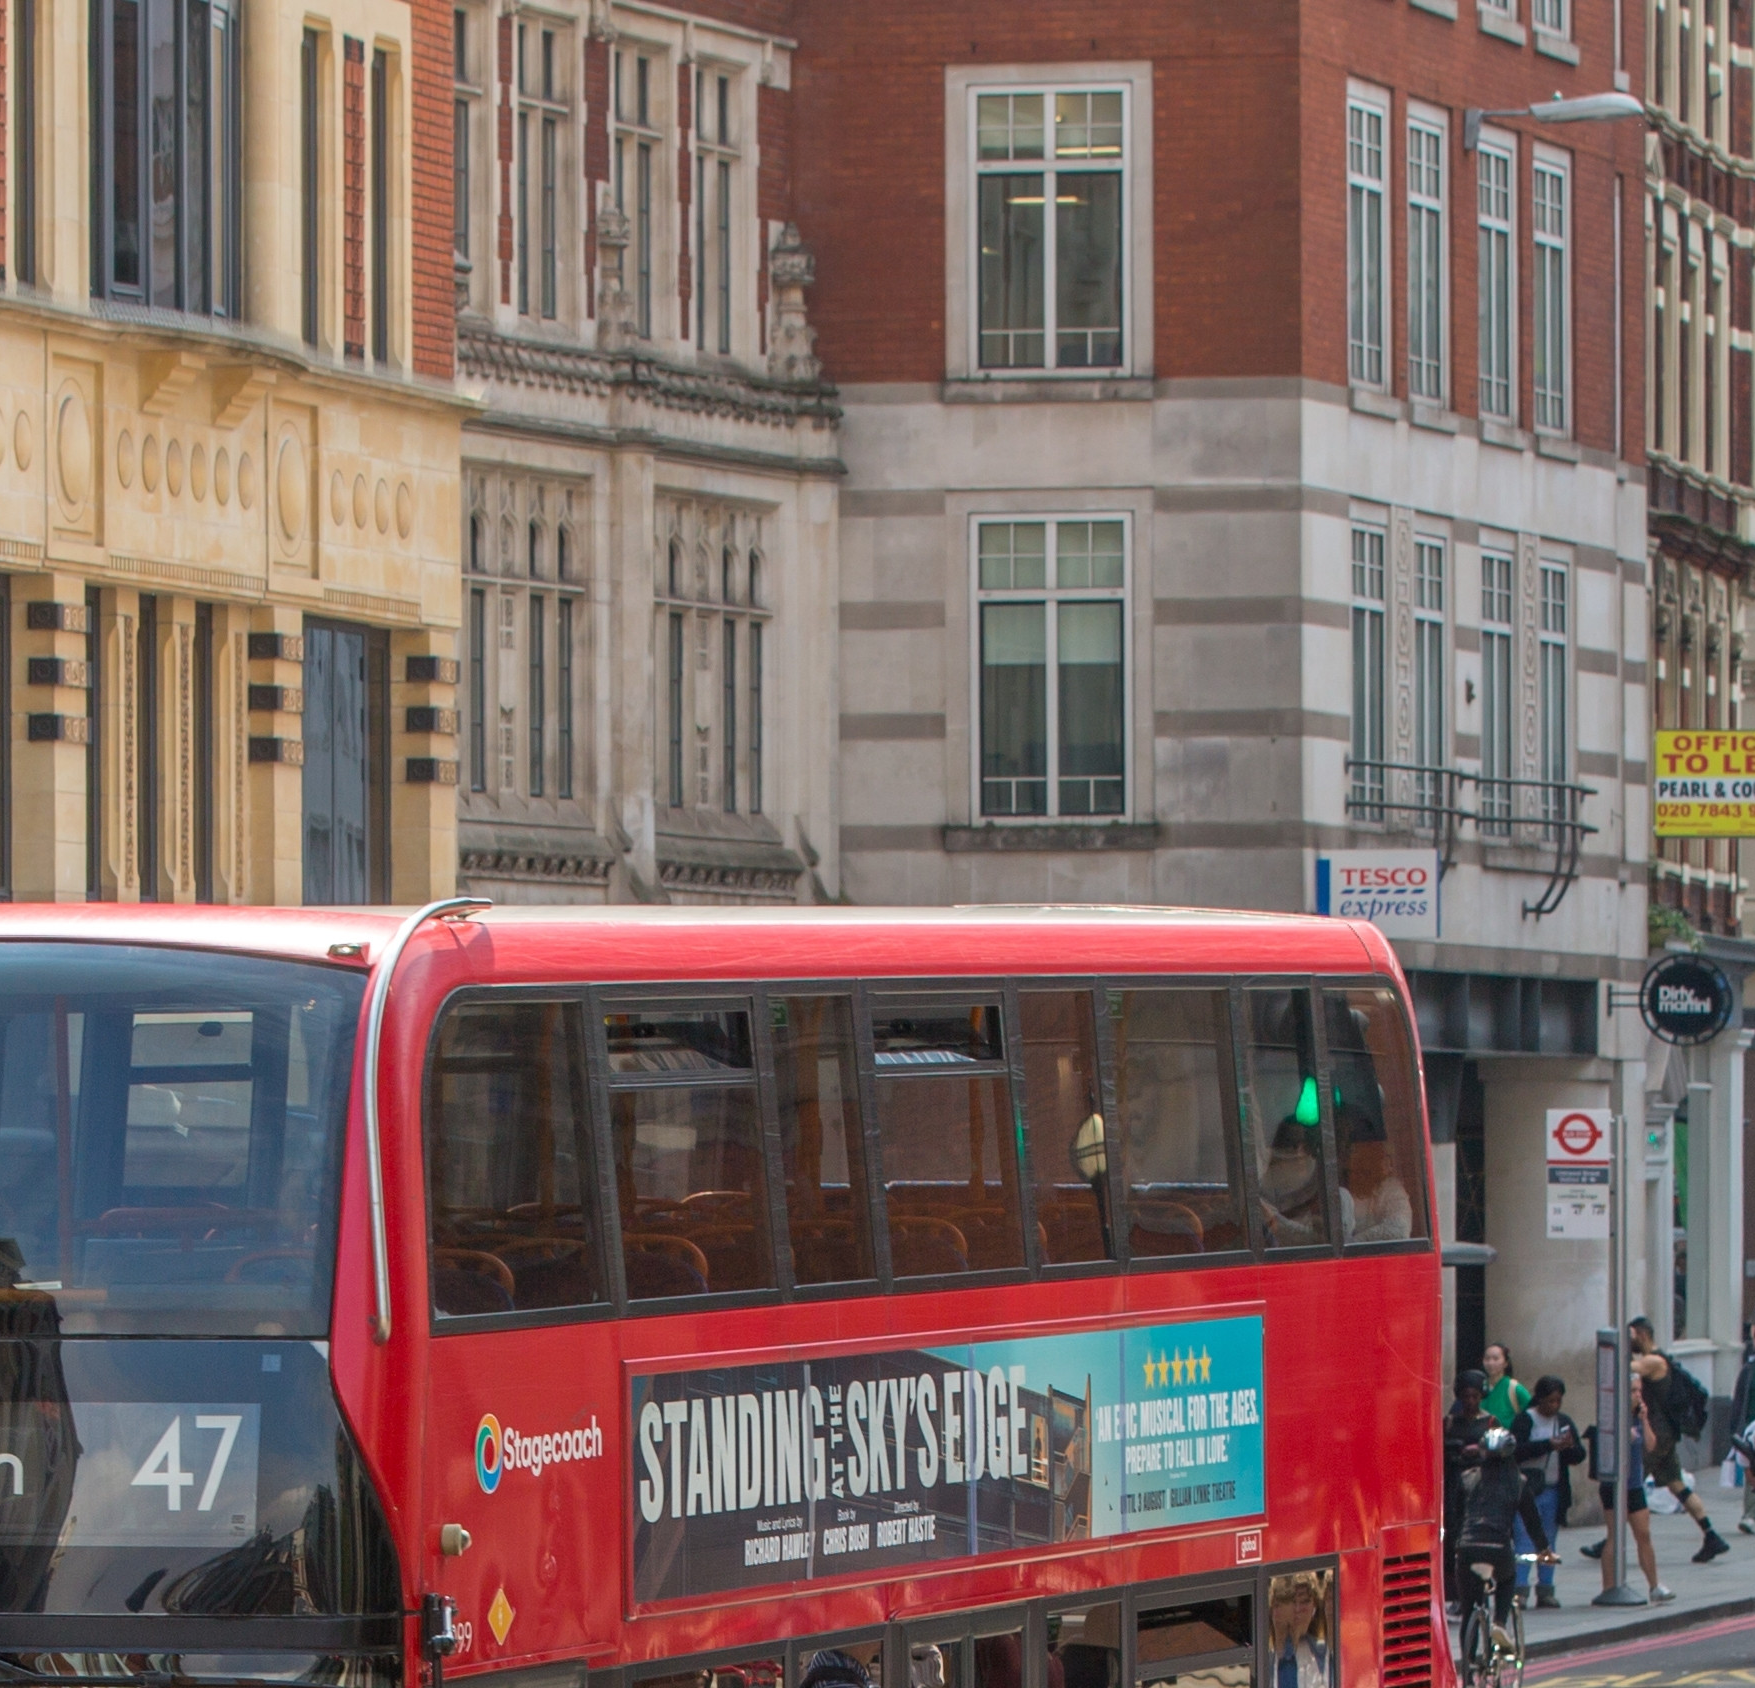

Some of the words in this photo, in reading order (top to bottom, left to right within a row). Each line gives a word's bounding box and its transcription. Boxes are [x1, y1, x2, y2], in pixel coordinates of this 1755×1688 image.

[1662, 754, 1708, 774] TO
[1659, 781, 1710, 798] PEARL
[1715, 781, 1725, 798] &
[1657, 804, 1691, 818] 020
[1697, 804, 1742, 818] 7843
[1339, 867, 1427, 886] TESCO
[1339, 898, 1428, 921] express
[828, 1382, 842, 1449] THE
[942, 1364, 1029, 1486] EDGE
[1139, 1397, 1186, 1438] MUSICAL
[1187, 1394, 1208, 1434] FOR
[1209, 1391, 1230, 1430] THE
[1231, 1388, 1260, 1428] AGES.
[130, 1414, 243, 1512] 47
[502, 1414, 603, 1478] Stagecoach
[639, 1384, 827, 1524] STANDING
[1125, 1442, 1162, 1475] PREPARE
[1163, 1441, 1174, 1471] TO
[1176, 1439, 1195, 1468] FALL
[1195, 1438, 1206, 1466] IN
[830, 1457, 845, 1499] AT
[1142, 1489, 1167, 1512] AUGUST
[1170, 1487, 1193, 1509] GILLIAN
[1193, 1483, 1211, 1506] LYNNE
[1211, 1480, 1236, 1502] THEATRE
[823, 1525, 847, 1556] CHRIS
[848, 1523, 870, 1552] BUSH
[876, 1518, 907, 1548] ROBERT
[907, 1514, 937, 1544] HASTIE
[744, 1535, 780, 1567] RICHARD
